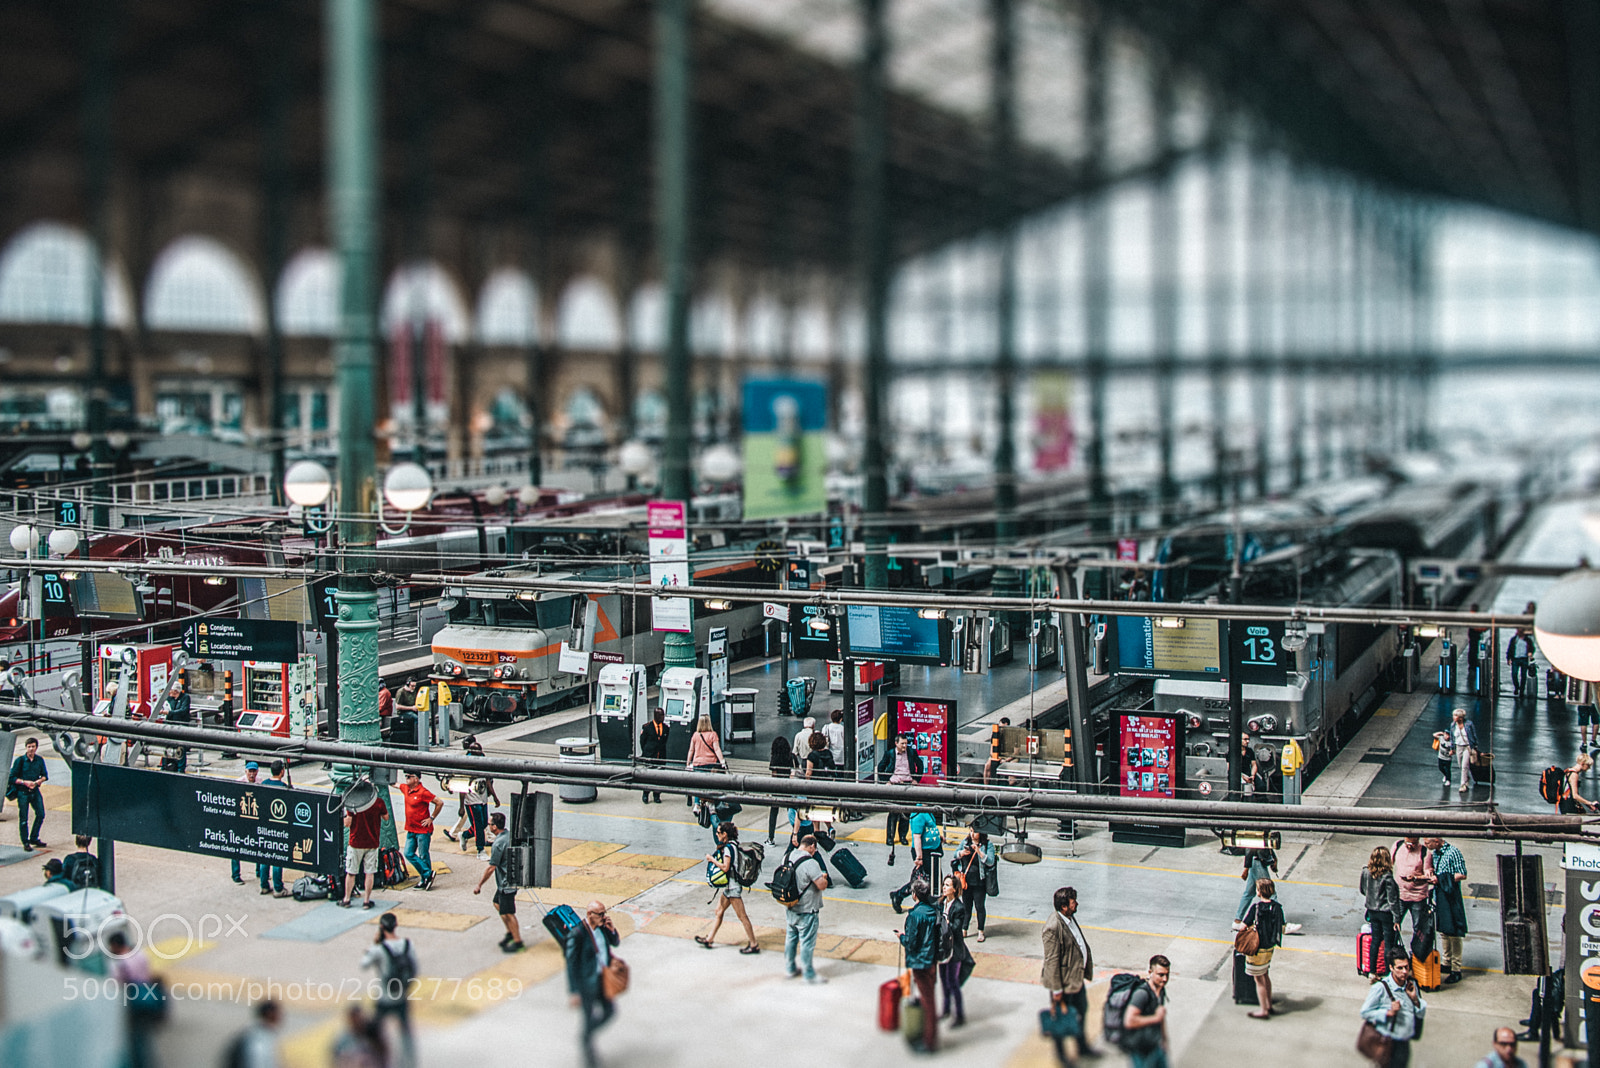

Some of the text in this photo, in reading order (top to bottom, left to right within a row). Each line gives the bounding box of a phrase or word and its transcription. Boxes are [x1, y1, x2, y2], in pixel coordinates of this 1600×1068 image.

[61, 509, 76, 522] 10
[184, 556, 225, 567] THALYS
[44, 582, 64, 600] 10
[260, 577, 271, 620] nforation
[323, 596, 338, 615] 1
[806, 606, 818, 614] Voi
[53, 628, 69, 636] 4534
[210, 624, 235, 632] Consignes
[1249, 627, 1267, 635] Voie
[210, 642, 253, 652] Location voitures
[1144, 615, 1153, 669] informatio
[1243, 638, 1276, 662] 13
[593, 652, 623, 662] Bienvenue
[195, 790, 236, 807] Toilettes
[203, 805, 218, 814] Toilets
[297, 807, 309, 817] RER
[257, 826, 289, 839] Billetterie
[204, 828, 289, 852] Paris, Île-de-France
[221, 845, 236, 853] tickets
[1582, 942, 1600, 950] IDEN
